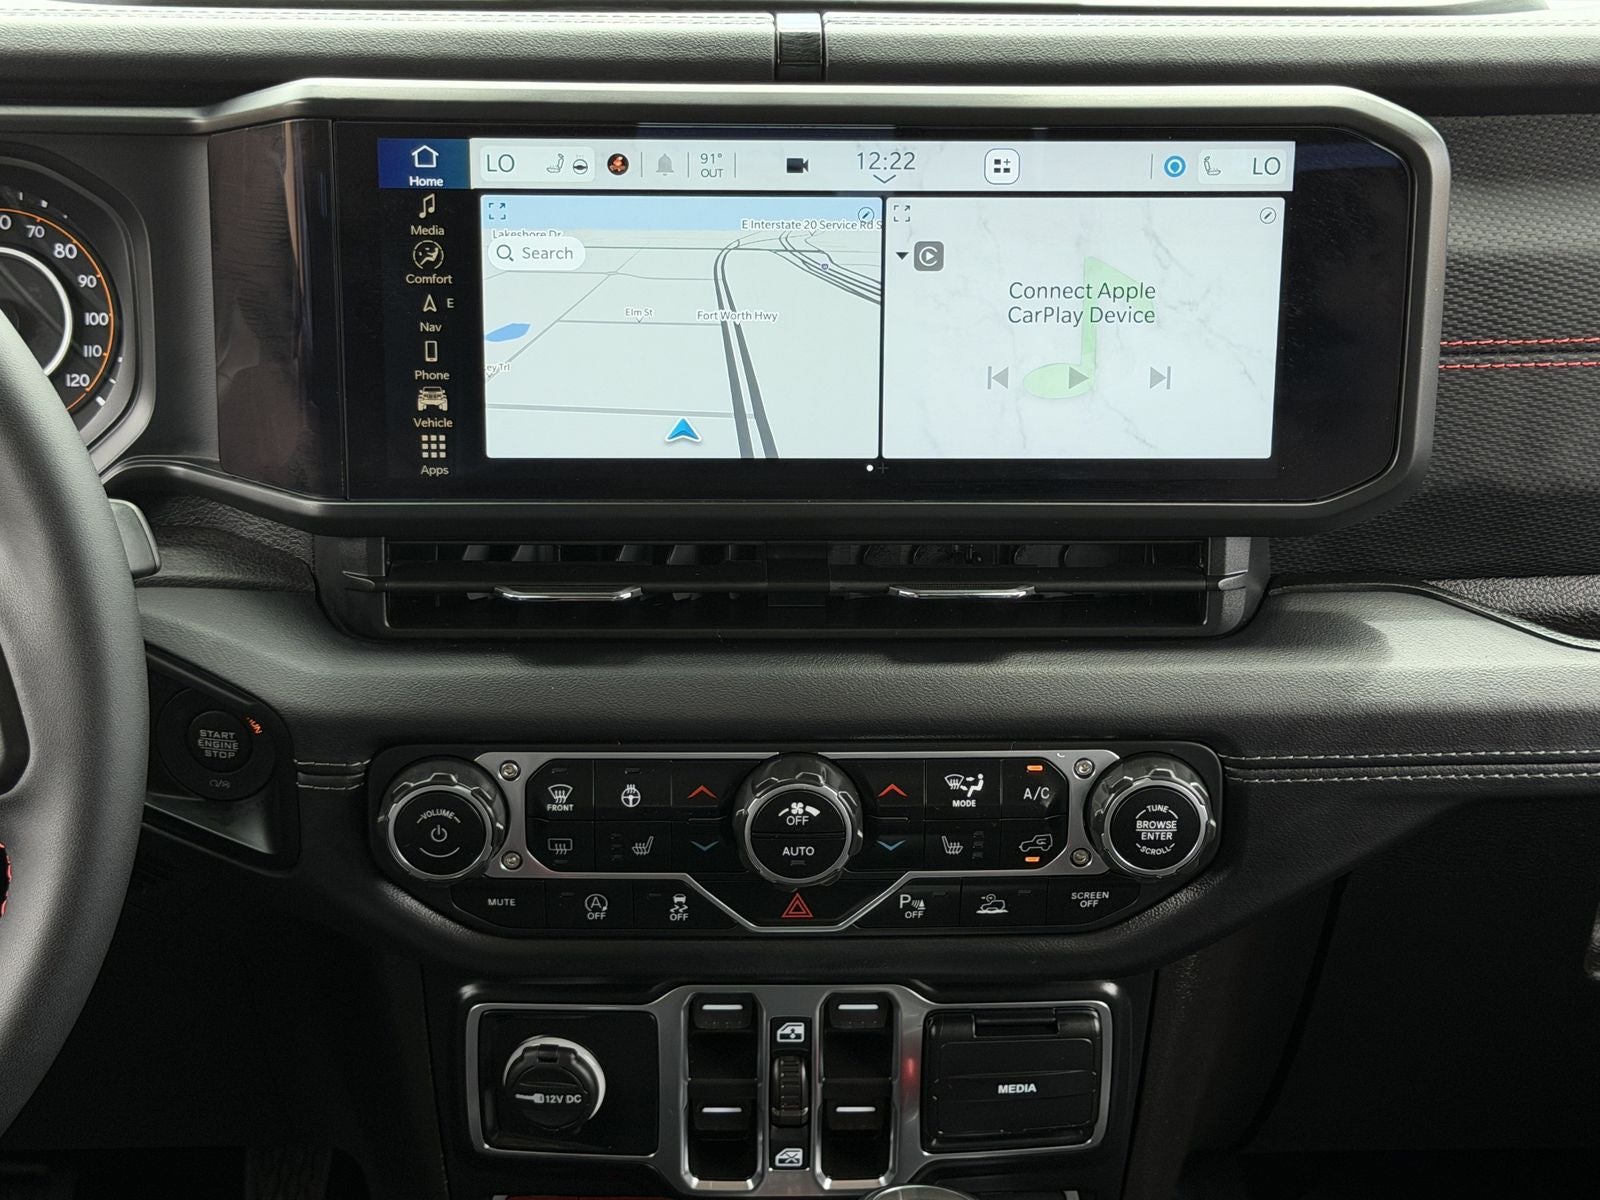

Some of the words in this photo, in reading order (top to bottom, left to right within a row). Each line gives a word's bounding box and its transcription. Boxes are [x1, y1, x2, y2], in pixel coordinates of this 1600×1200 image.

[487, 154, 515, 173] LO
[857, 151, 916, 171] 12:22
[1253, 156, 1281, 176] LO
[700, 168, 723, 178] OUT
[409, 176, 444, 187] Home
[0, 215, 12, 230] 0
[742, 220, 749, 230] E
[750, 219, 802, 230] Interstate
[804, 220, 818, 230] 20
[820, 219, 858, 230] Service
[860, 220, 874, 230] Rd
[25, 225, 46, 239] 70
[410, 224, 445, 236] Media
[53, 243, 78, 260] 80
[521, 246, 574, 260] Search
[77, 274, 97, 288] 90
[405, 273, 453, 285] Comfort
[1009, 281, 1094, 301] Connect
[1097, 282, 1157, 304] Apple
[446, 298, 455, 309] E
[625, 308, 642, 316] Elm
[644, 308, 653, 316] St
[697, 310, 718, 321] Fort
[720, 310, 751, 321] Worth
[754, 310, 778, 323] Hwy
[1007, 305, 1085, 328] CarPlay
[1089, 305, 1156, 325] Device
[84, 312, 109, 327] 100
[419, 322, 442, 333] Nav
[83, 345, 103, 358] 110
[486, 365, 497, 373] ey
[414, 369, 450, 381] Phone
[66, 374, 90, 388] 120
[413, 417, 454, 429] Vehicle
[420, 465, 450, 477] Apps
[199, 729, 236, 740] START
[198, 739, 239, 750] ENGINE
[204, 749, 236, 759] STOP
[1023, 787, 1050, 801] A/C
[546, 804, 574, 812] FRONT
[952, 800, 976, 808] MODE
[1146, 804, 1169, 814] TUNE
[419, 809, 456, 819] VOLUME
[786, 816, 809, 826] OFF
[1136, 820, 1178, 830] BROWSE
[1141, 832, 1173, 842] ENTER
[782, 846, 815, 857] AUTO
[1139, 844, 1173, 856] SCROLL
[1071, 891, 1110, 901] SCREEN
[488, 898, 516, 907] MUTE
[1079, 900, 1099, 909] OFF
[587, 911, 606, 920] OFF
[669, 912, 689, 921] OFF
[904, 911, 924, 919] OFF
[997, 1083, 1037, 1095] MEDIA
[545, 1094, 564, 1104] 12V
[566, 1094, 582, 1104] DC
